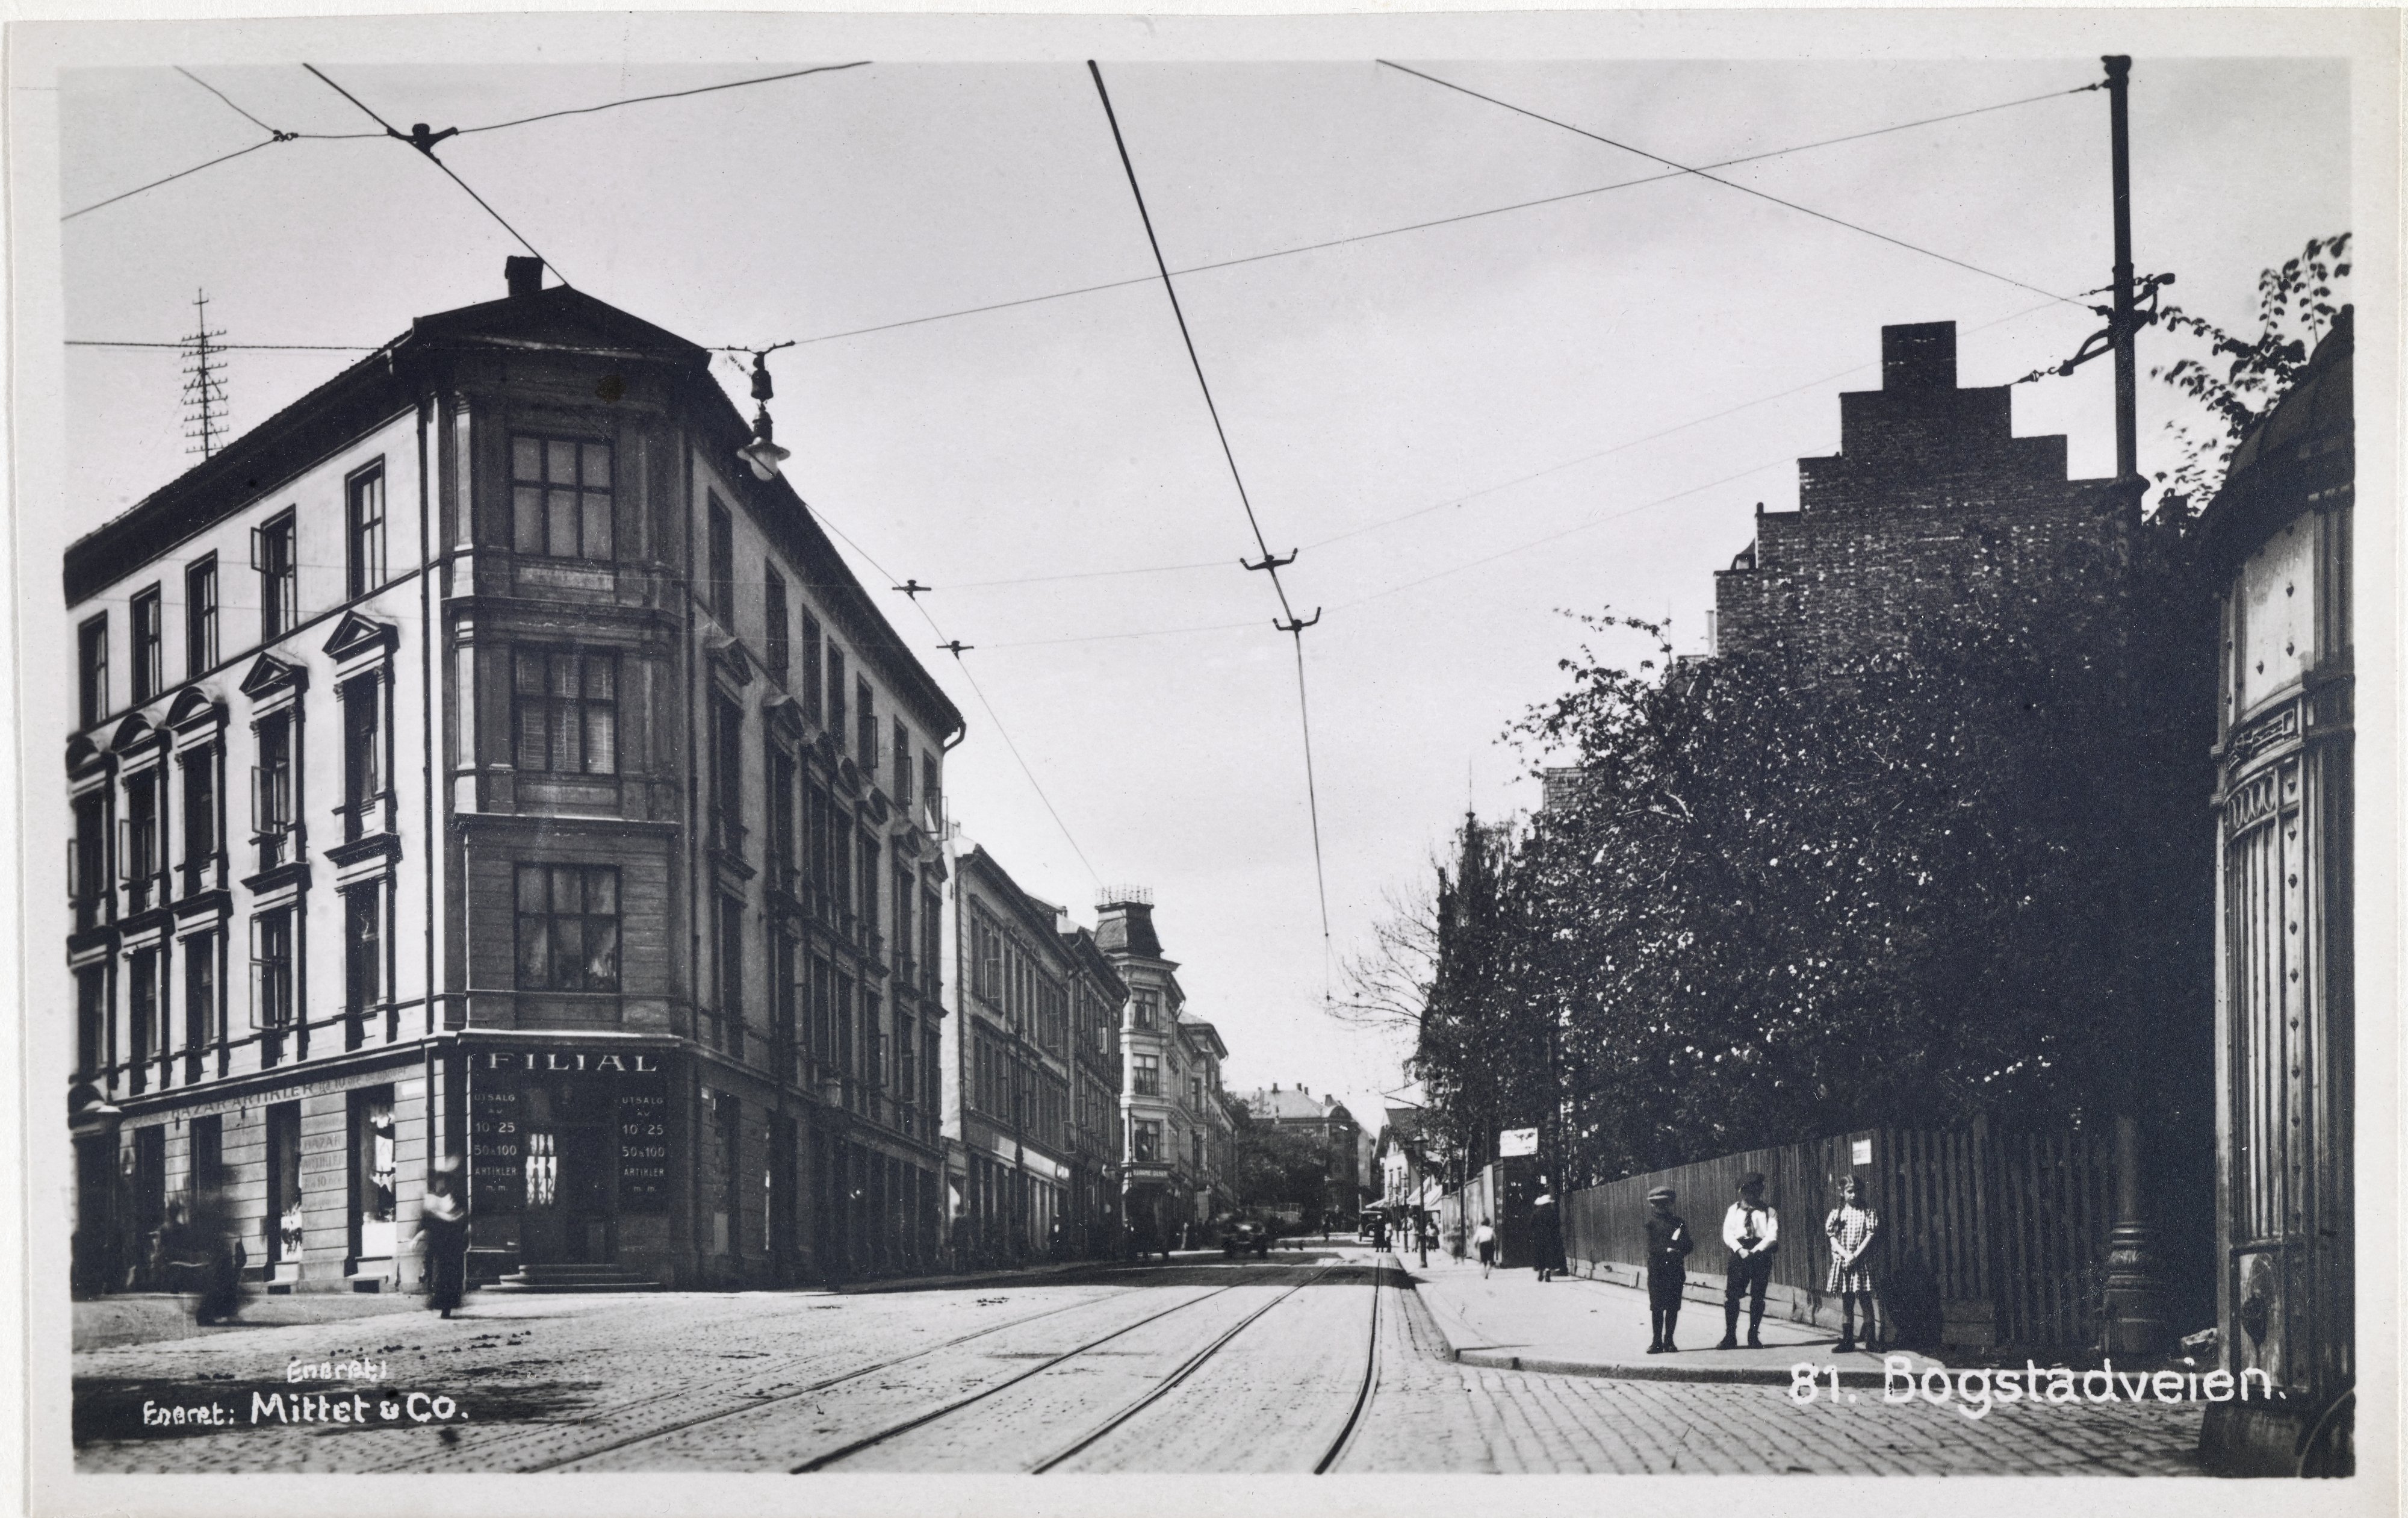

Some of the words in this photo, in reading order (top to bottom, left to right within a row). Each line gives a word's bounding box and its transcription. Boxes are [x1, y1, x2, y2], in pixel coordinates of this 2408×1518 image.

[489, 1053, 657, 1072] FILIAL
[474, 1093, 515, 1103] UTSALG
[622, 1097, 664, 1105] UTSALG
[476, 1122, 490, 1132] 10
[498, 1122, 515, 1133] 25
[622, 1124, 638, 1134] 10
[648, 1124, 663, 1135] 25
[474, 1167, 517, 1176] ARTIKLER
[624, 1168, 664, 1177] ARTIKLER
